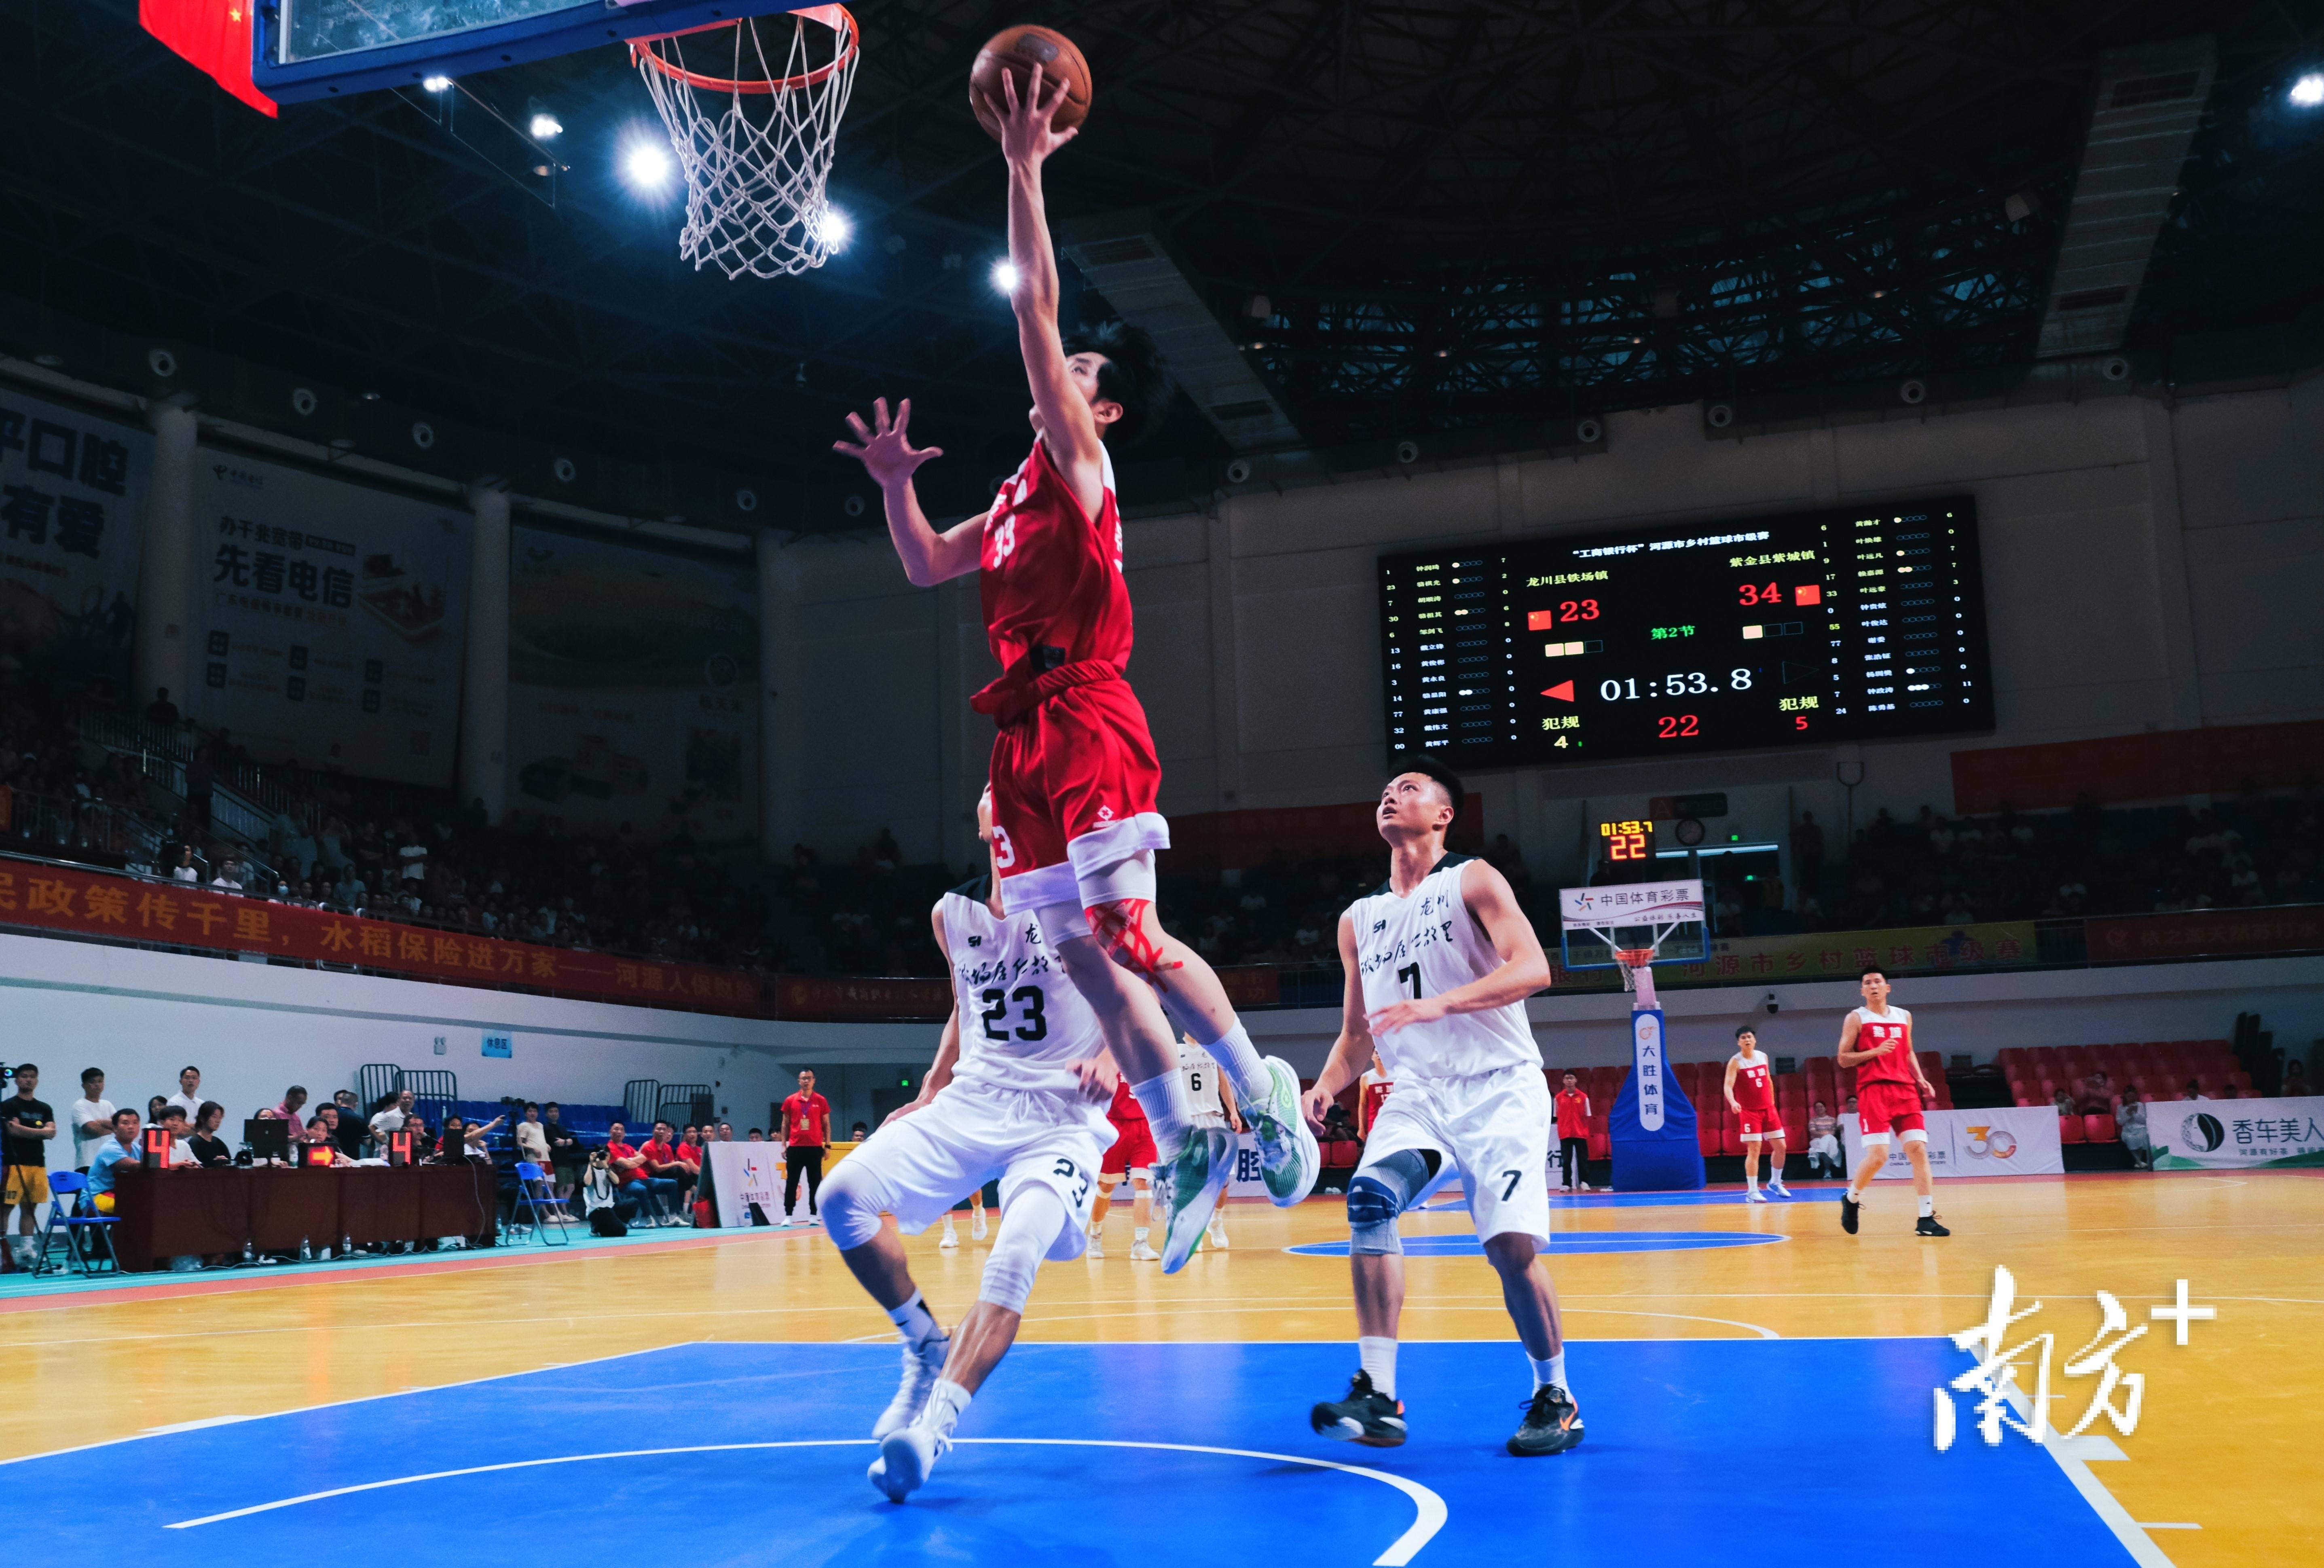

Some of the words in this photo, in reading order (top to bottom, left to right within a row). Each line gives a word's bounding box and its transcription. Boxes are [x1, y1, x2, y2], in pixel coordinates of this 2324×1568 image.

[993, 512, 1016, 568] 33
[1730, 550, 1815, 567] 紫金县紫城镇
[214, 544, 354, 608] 先看电信
[1527, 571, 1608, 587] 龙川县铁场镇
[1739, 582, 1782, 605] 34
[1560, 599, 1599, 622] 23
[1651, 625, 1695, 639] 第2节
[1779, 696, 1819, 711] 犯规
[1542, 716, 1580, 730] 犯规
[1658, 715, 1699, 738] 22
[1796, 716, 1808, 730] 5
[1554, 736, 1568, 748] 4
[1601, 821, 1653, 837] 01:53.7
[992, 825, 1015, 868] 3
[1610, 834, 1646, 860] 22
[1601, 888, 1690, 907] 中国体育彩票
[1398, 962, 1421, 999] 7
[981, 985, 1047, 1042] 23
[486, 1037, 507, 1049] 休息区
[1191, 1073, 1201, 1091] 6
[1642, 1046, 1658, 1116] 大胜体育
[1755, 1078, 1763, 1088] 6
[1744, 1123, 1751, 1133] 6
[2233, 1117, 2324, 1144] 香车美人
[148, 1130, 169, 1169] 4
[393, 1132, 411, 1164] 4
[1964, 1126, 2017, 1159] 30
[1547, 1150, 1562, 1168] 行
[1053, 1158, 1088, 1208] 23
[1502, 1169, 1522, 1202] 7
